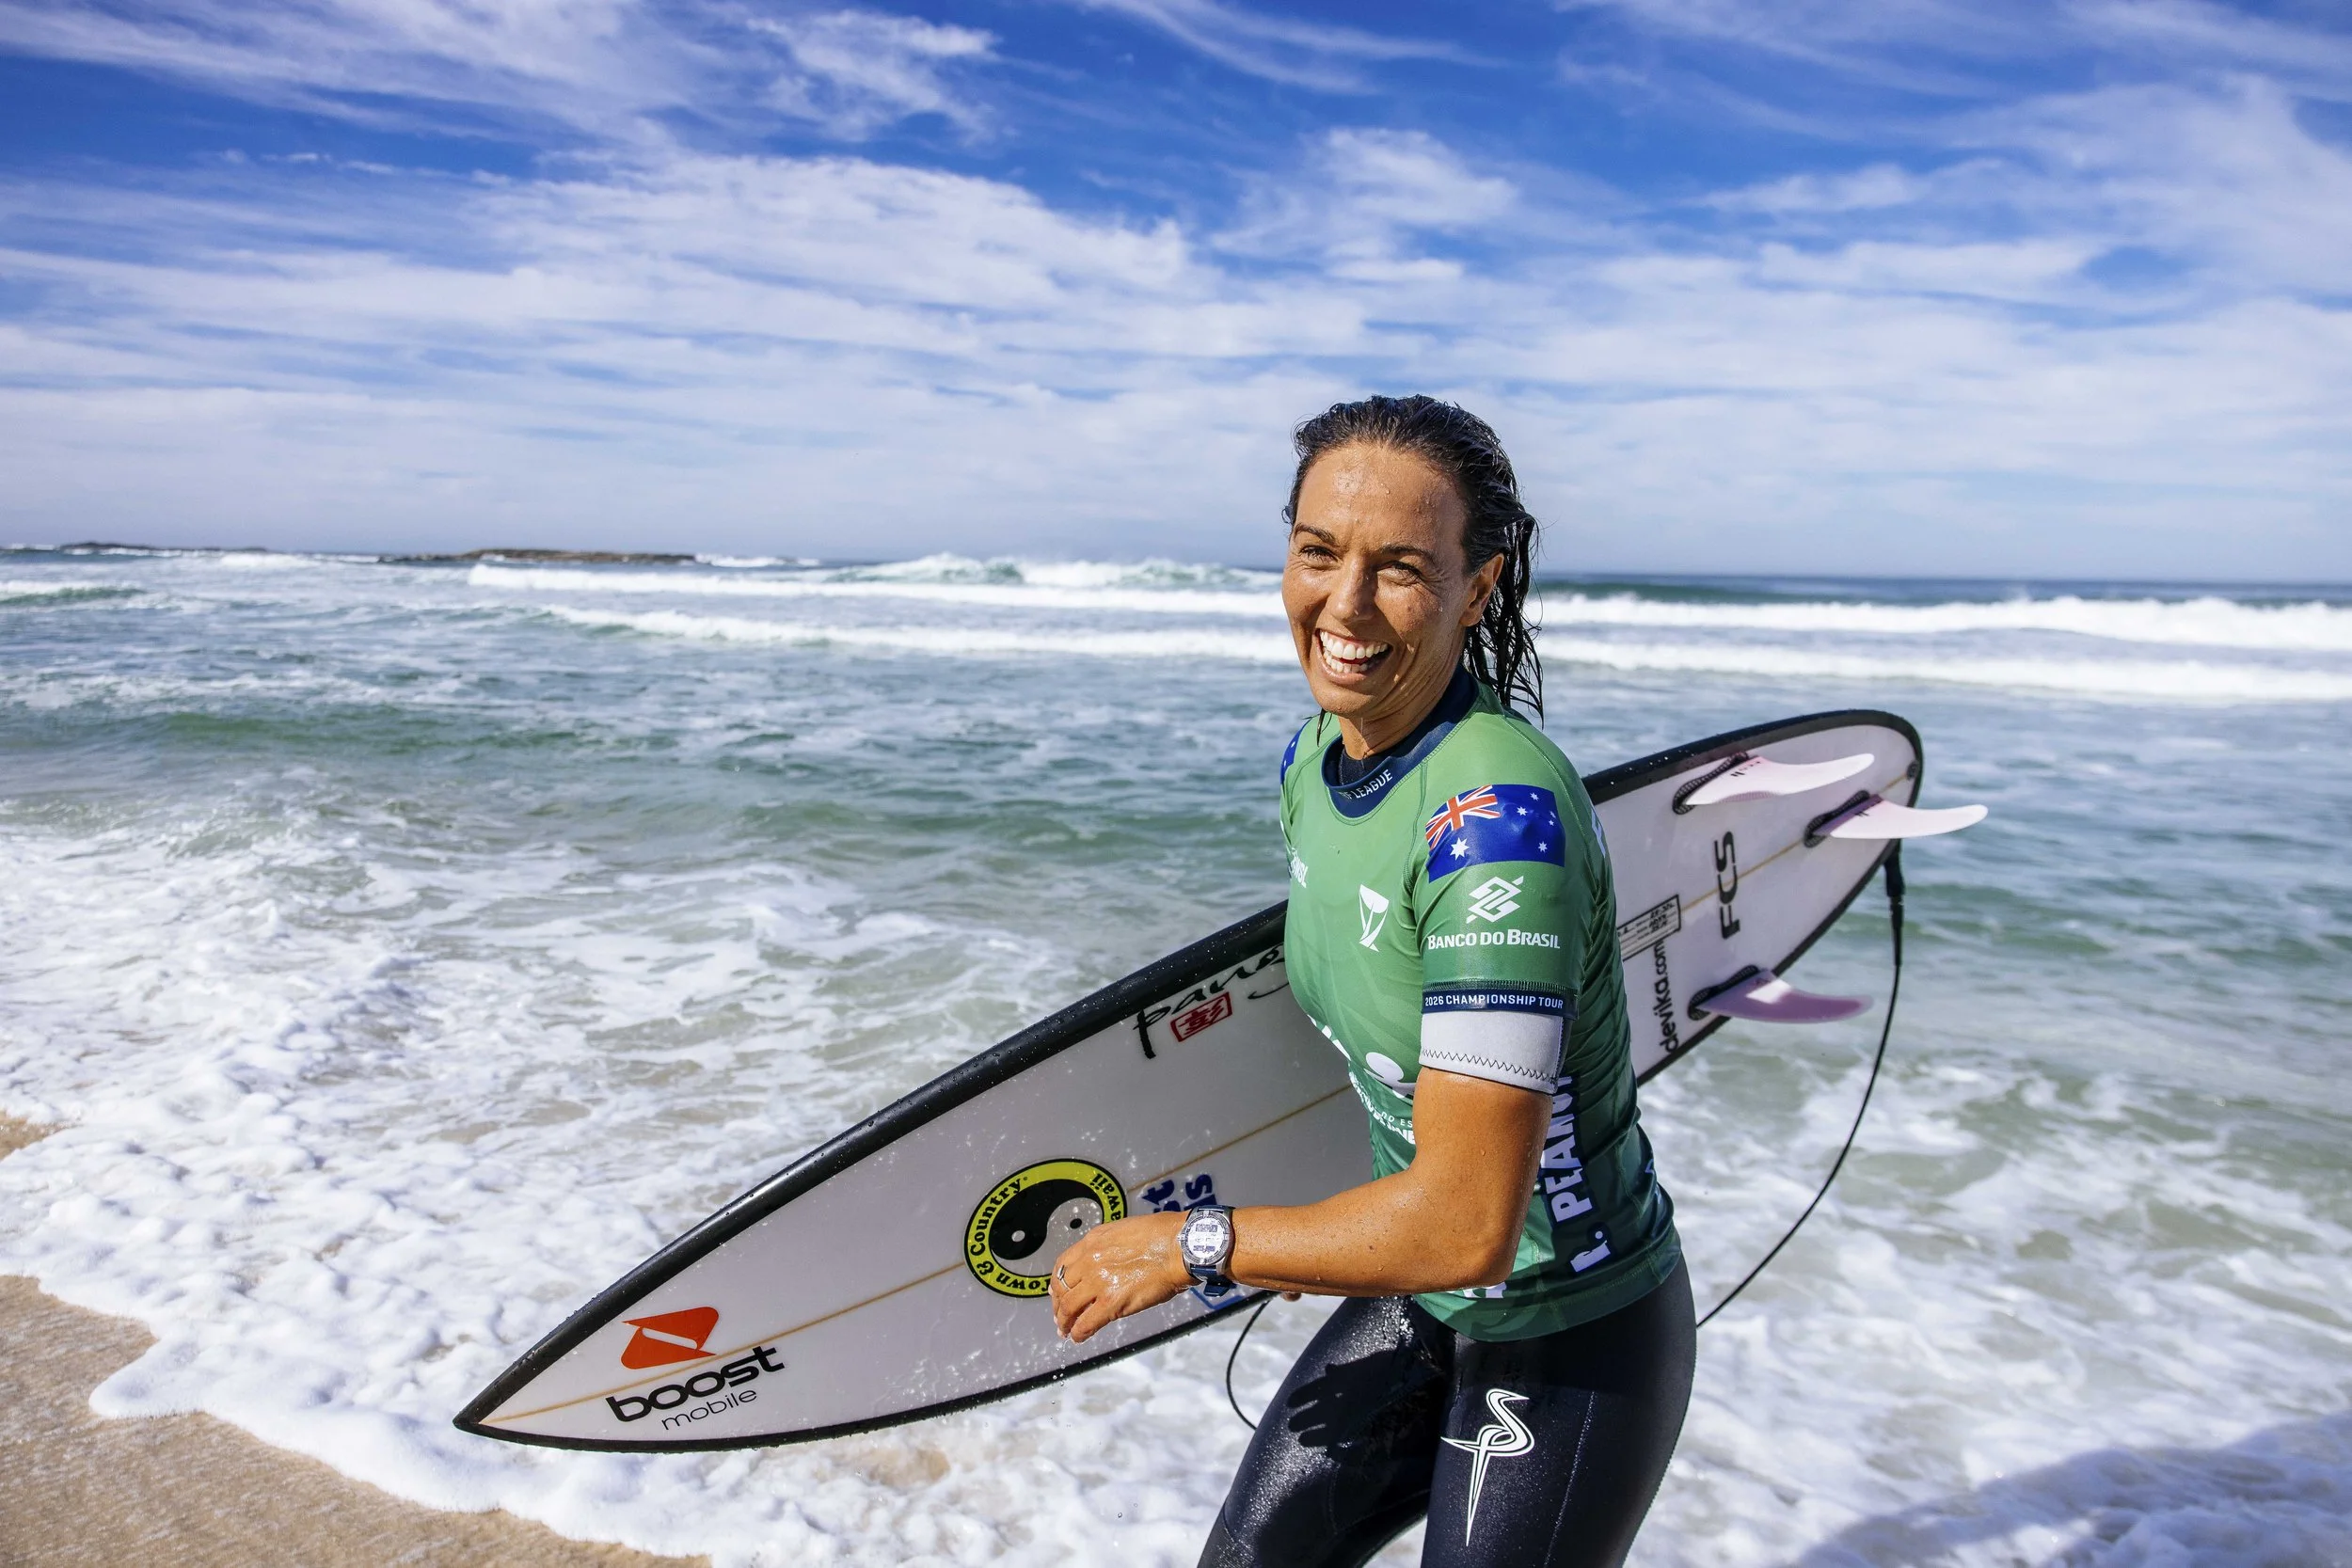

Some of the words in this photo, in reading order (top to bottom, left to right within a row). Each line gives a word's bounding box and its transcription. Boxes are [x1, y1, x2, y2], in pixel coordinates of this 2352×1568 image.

[1350, 768, 1393, 799] LEAGUE
[1713, 831, 1740, 940] FCS
[1427, 932, 1477, 950] BANCO
[1480, 931, 1504, 946] DO
[1507, 928, 1561, 949] BRASIL
[1425, 995, 1444, 1006] 2026
[1445, 994, 1536, 1006] CHAMPIONSHIP
[1538, 996, 1564, 1009] TOUR
[1653, 940, 1679, 1053] devika.com
[1089, 1173, 1121, 1222] awaii
[976, 1259, 994, 1275] &
[605, 1345, 786, 1422] boost
[660, 1389, 757, 1431] mobile
